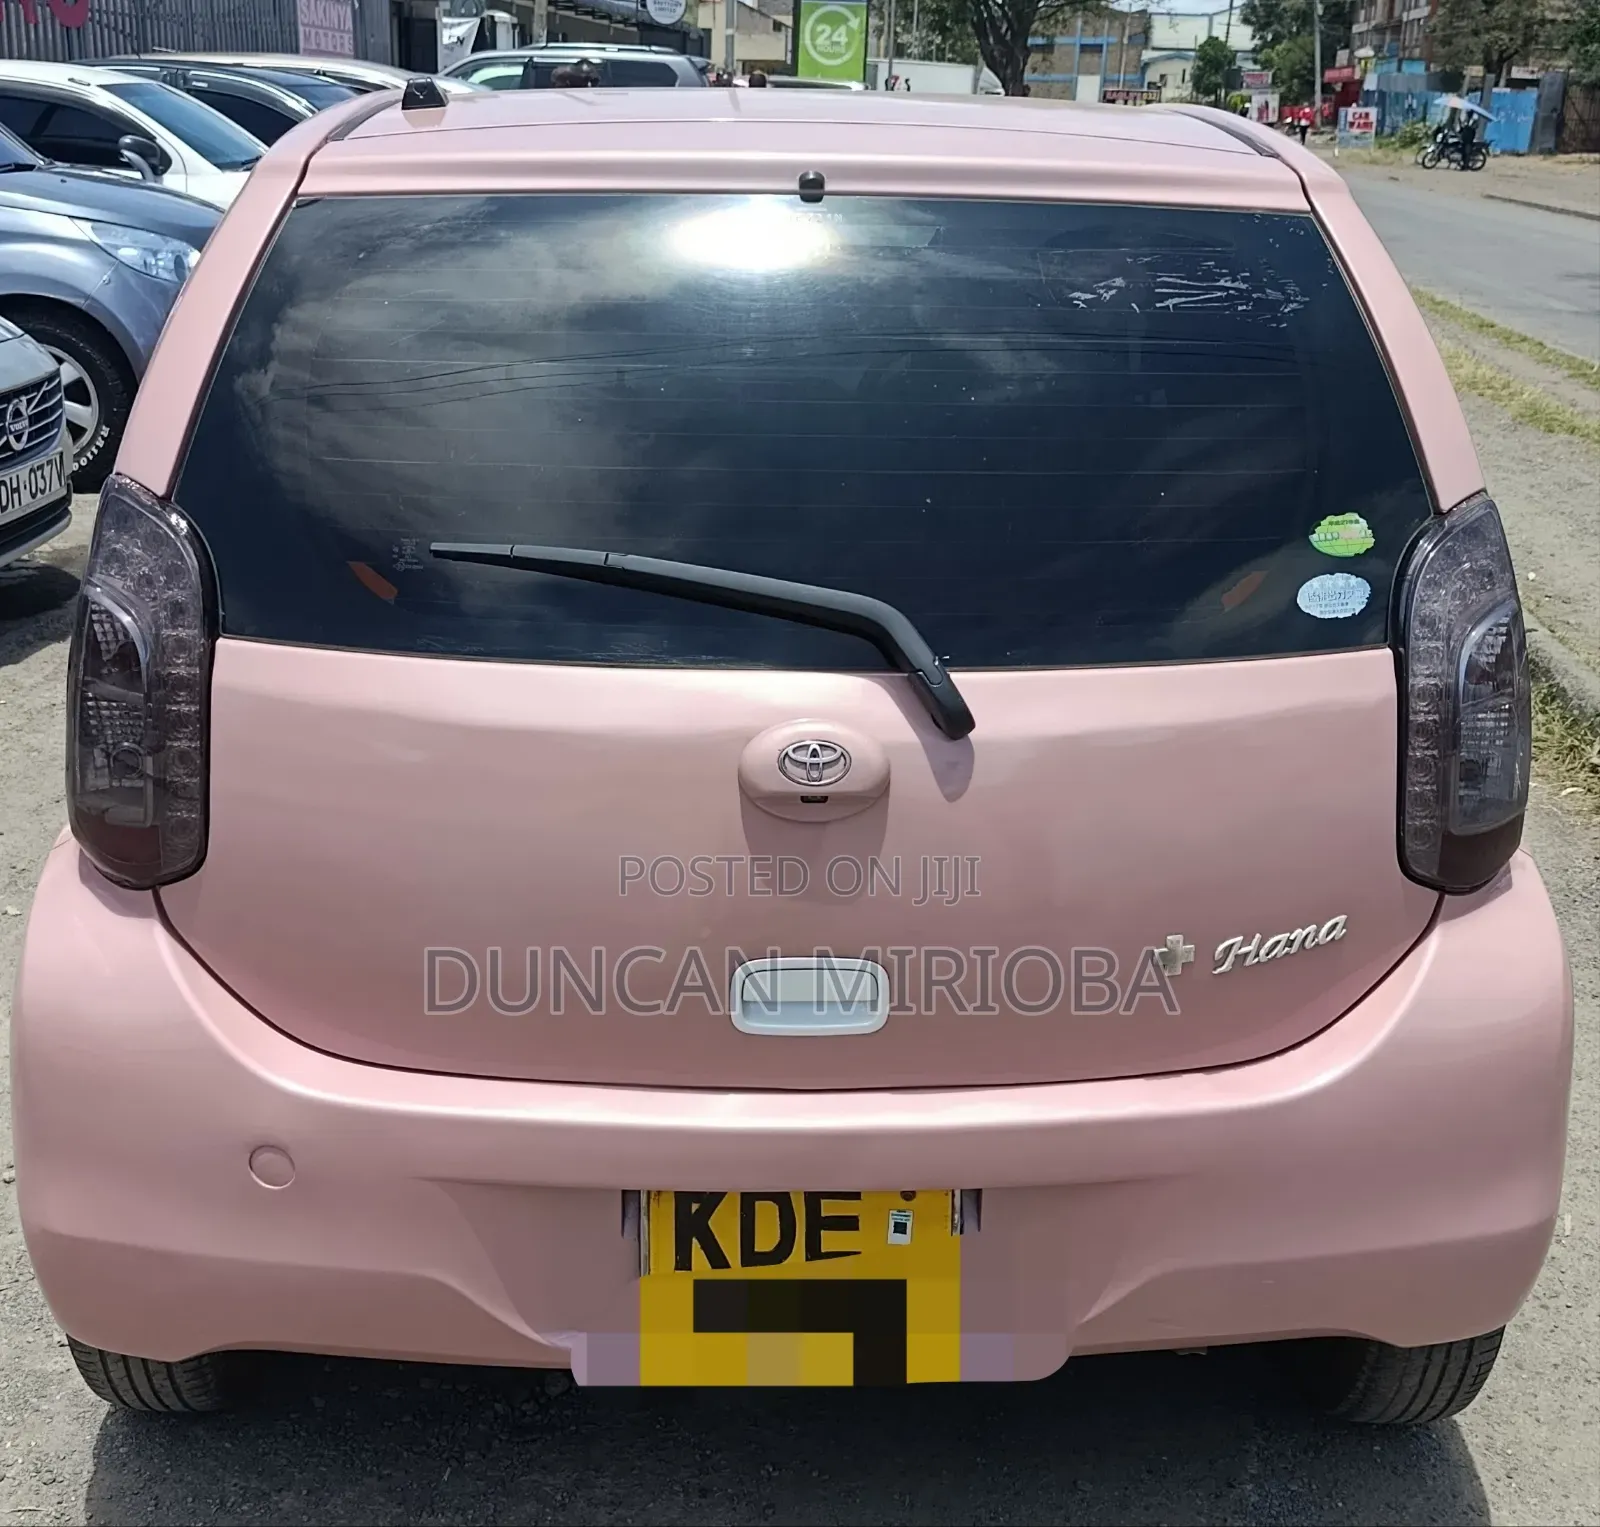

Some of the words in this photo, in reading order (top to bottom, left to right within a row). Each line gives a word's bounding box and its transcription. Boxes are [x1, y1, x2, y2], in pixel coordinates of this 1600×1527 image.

[303, 28, 354, 53] MOTORS
[815, 23, 849, 46] 24
[1211, 913, 1348, 976] Hana
[673, 1191, 862, 1272] KDE
